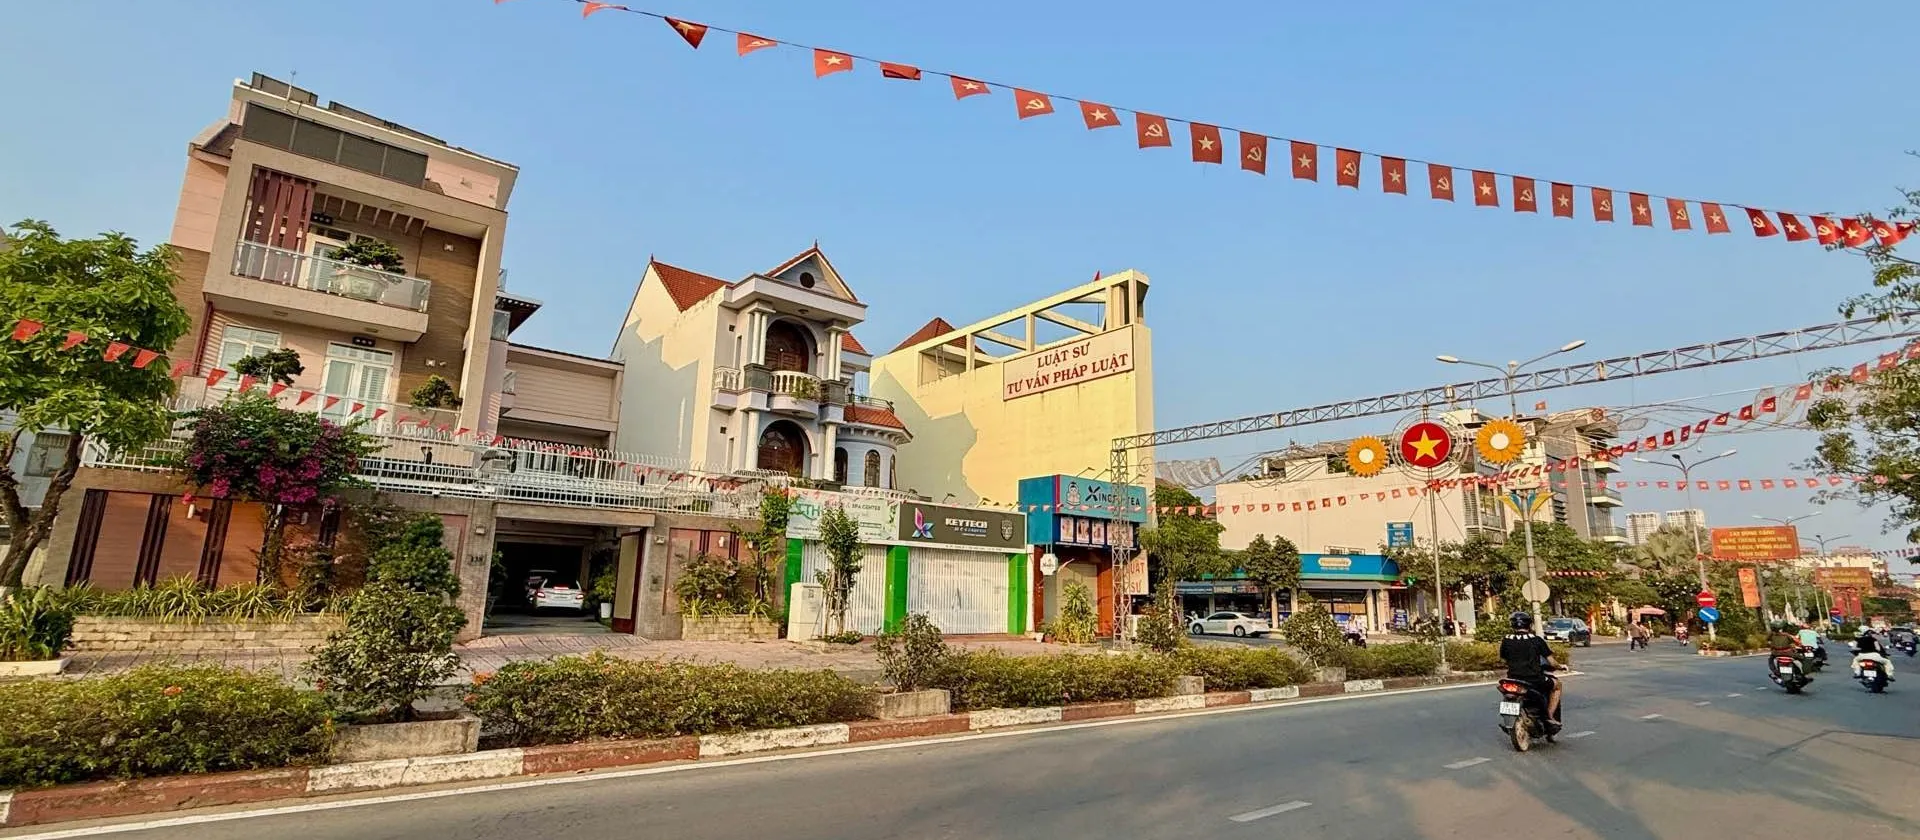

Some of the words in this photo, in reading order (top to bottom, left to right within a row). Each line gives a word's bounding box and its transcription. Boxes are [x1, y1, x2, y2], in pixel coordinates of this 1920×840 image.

[1037, 349, 1070, 368] LUẬT
[1072, 342, 1090, 359] SƯ
[1007, 378, 1023, 395] TƯ
[1025, 370, 1050, 390] VẤN
[1053, 363, 1088, 384] PHÁP
[1092, 353, 1129, 373] LUẬT
